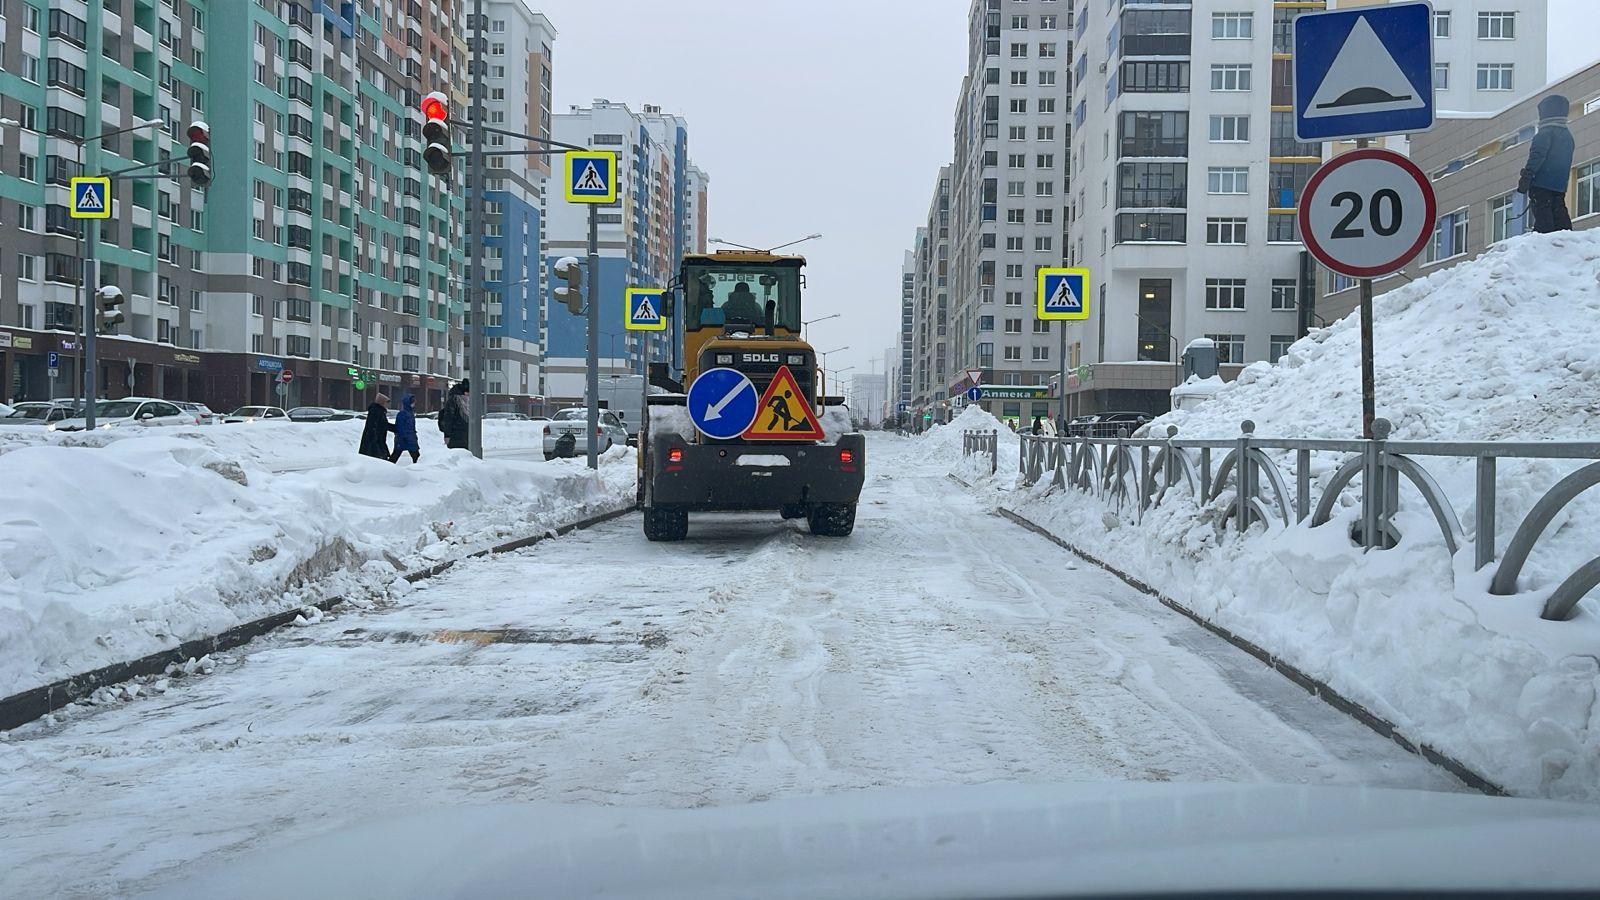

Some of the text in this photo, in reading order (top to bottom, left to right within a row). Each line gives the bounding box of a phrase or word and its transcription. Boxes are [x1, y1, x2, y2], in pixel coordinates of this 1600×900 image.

[1330, 188, 1403, 240] 20
[50, 353, 57, 366] P
[742, 353, 779, 362] SDLG
[981, 389, 1031, 398] Аптека
